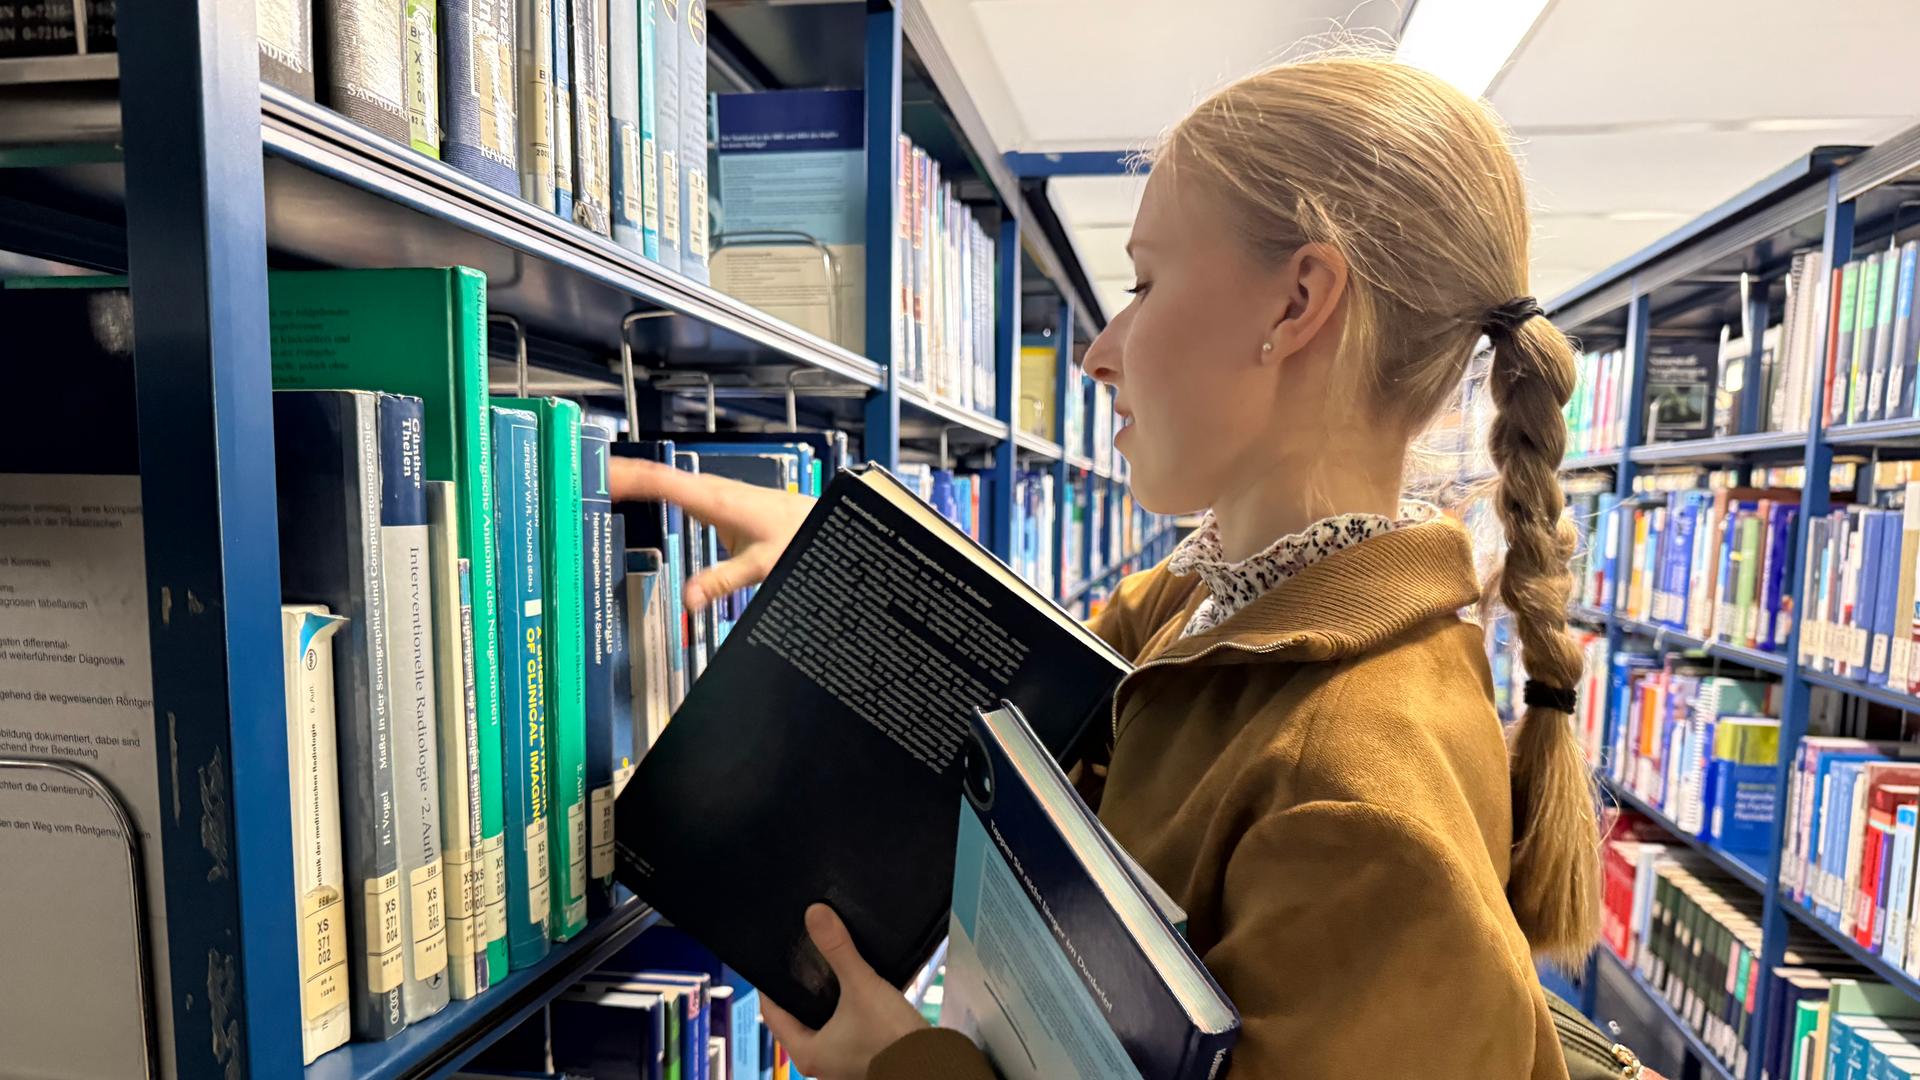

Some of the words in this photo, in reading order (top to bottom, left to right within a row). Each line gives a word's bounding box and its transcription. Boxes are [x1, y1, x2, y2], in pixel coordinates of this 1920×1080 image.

[402, 418, 412, 477] Thelen
[412, 418, 422, 489] Günther
[479, 405, 492, 514] Radiologische
[523, 439, 533, 486] JEREMY
[595, 445, 609, 495] 1
[365, 422, 379, 577] Computertomographie
[527, 488, 535, 515] W.R.
[484, 515, 494, 586] Anatomie
[528, 517, 536, 564] YOUNG
[592, 511, 602, 592] Herausgegeben
[371, 580, 381, 604] und
[528, 565, 537, 593] (Eds.)
[39, 598, 88, 611] tabellarisch
[487, 589, 495, 610] des
[594, 594, 602, 613] von
[409, 547, 425, 692] Interventionelle
[23, 637, 71, 651] differential-
[372, 608, 386, 692] Sonographie
[526, 627, 536, 654] OF
[10, 653, 76, 665] weiterführender
[79, 654, 126, 668] Diagnostik
[487, 613, 498, 727] Neugeborenen
[0, 690, 31, 702] gehend
[34, 691, 46, 701] die
[50, 694, 113, 707] wegweisenden
[377, 693, 386, 716] der
[527, 659, 540, 747] CLINICAL
[0, 728, 32, 743] bildung
[35, 731, 94, 746] dokumentiert,
[96, 735, 120, 746] dabei
[122, 736, 141, 747] sind
[310, 722, 319, 773] Radiologie
[378, 732, 390, 770] Maße
[416, 696, 430, 792] Radiologie
[30, 744, 49, 755] ihrer
[52, 746, 99, 761] Bedeutung
[25, 780, 39, 791] die
[41, 783, 95, 800] Orientierung
[312, 775, 322, 840] medizinischen
[380, 791, 394, 829] Vogel
[15, 819, 30, 830] den
[33, 821, 53, 834] Weg
[55, 825, 73, 834] vom
[315, 857, 327, 888] chnik
[475, 868, 484, 883] XS
[427, 886, 438, 902] XS
[985, 819, 1015, 859] Tappen
[1010, 856, 1025, 875] Sie
[1021, 874, 1043, 903] nicht
[1063, 938, 1079, 957] im
[386, 898, 397, 914] XS
[428, 903, 439, 918] 371
[317, 918, 329, 936] XS
[386, 915, 398, 931] 371
[318, 935, 331, 952] 371
[387, 930, 399, 945] 004
[318, 952, 332, 967] 002
